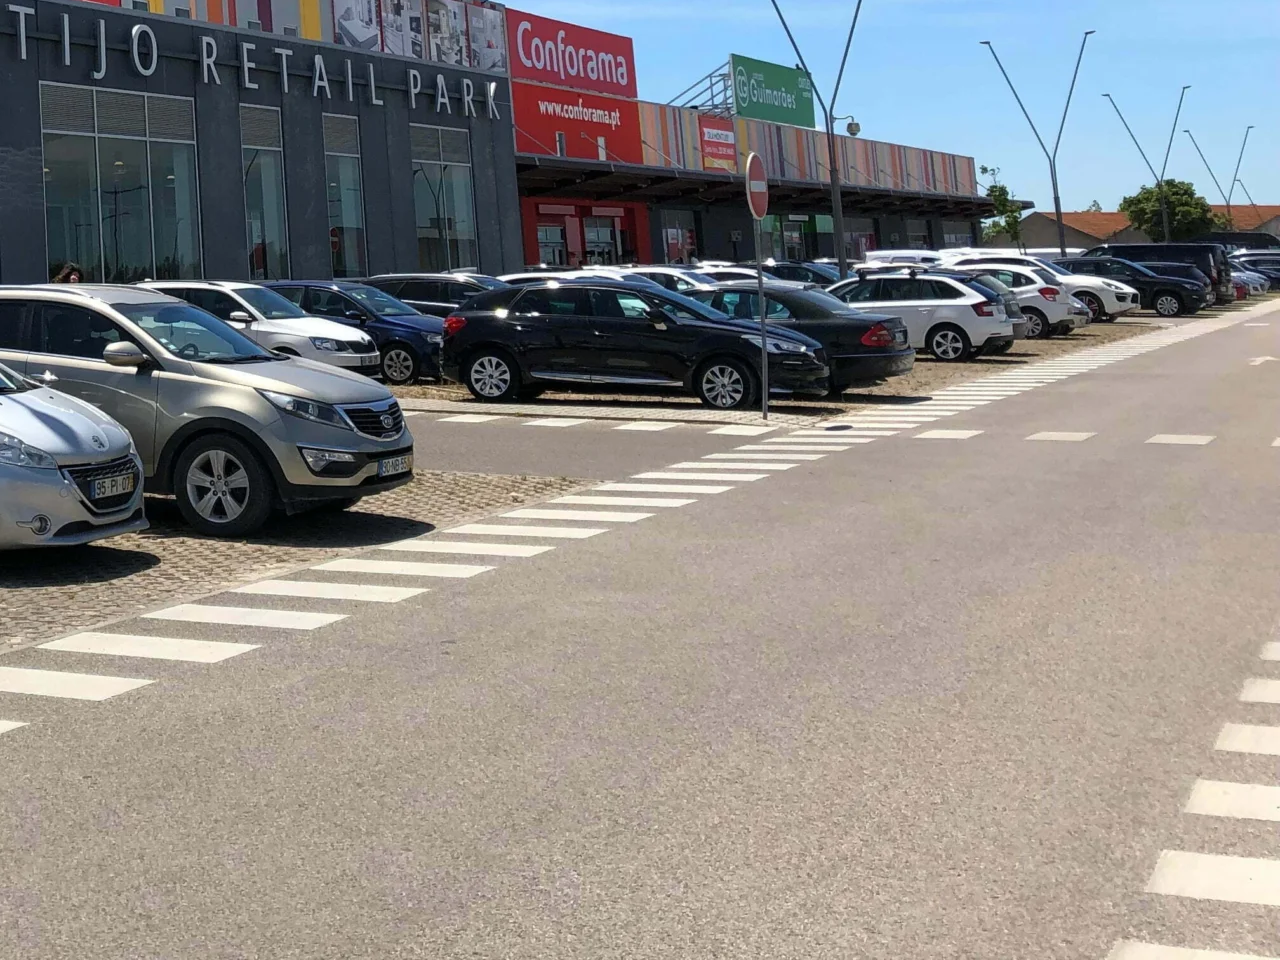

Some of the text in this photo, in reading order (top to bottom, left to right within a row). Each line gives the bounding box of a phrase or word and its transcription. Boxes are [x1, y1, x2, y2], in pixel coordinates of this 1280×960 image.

[198, 35, 384, 106] RETAIL
[406, 68, 501, 120] PARK
[516, 20, 628, 86] Conforama
[538, 97, 621, 134] www.conforama.pt
